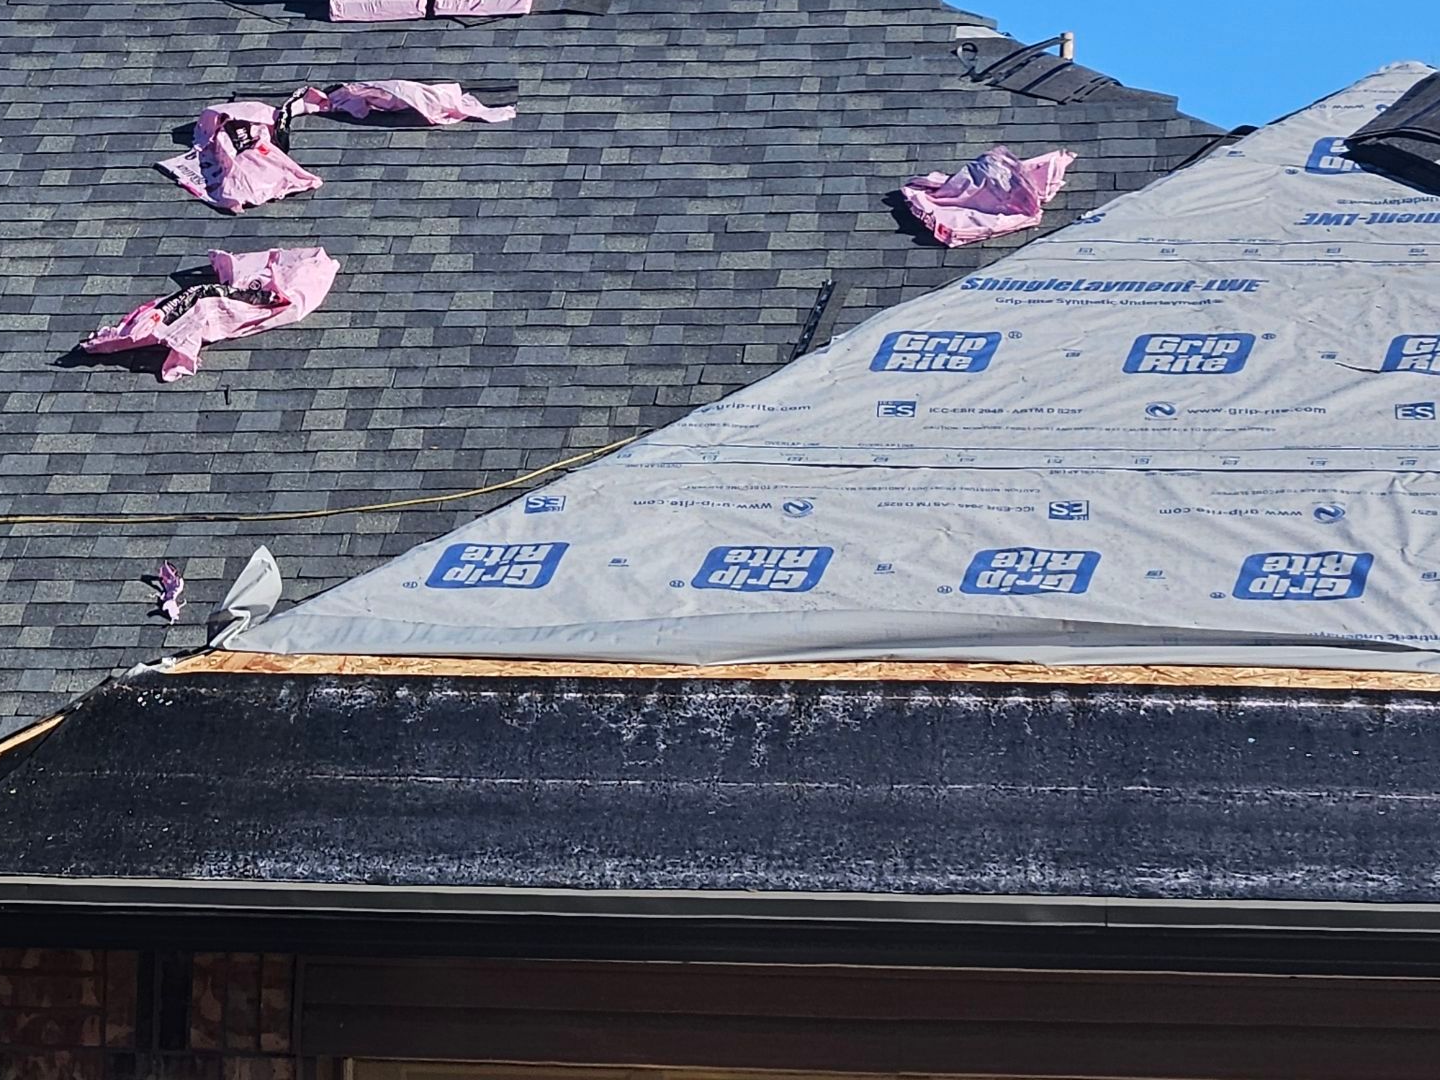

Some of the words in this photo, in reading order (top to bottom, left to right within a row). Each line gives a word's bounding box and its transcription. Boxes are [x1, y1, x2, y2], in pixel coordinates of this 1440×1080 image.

[961, 276, 1269, 292] ShingleLayment-LWE
[893, 333, 987, 352] Grip
[1145, 336, 1241, 355] Grip
[885, 353, 973, 371] Rite
[1138, 354, 1228, 372] Rite
[699, 402, 811, 413] w.grip-rite.com
[880, 406, 915, 418] ES
[1187, 405, 1327, 415] www.grip-rite.com
[1397, 406, 1434, 419] ES
[528, 497, 564, 508] ES
[1051, 501, 1088, 516] ES
[1159, 507, 1303, 517] www.grip-rite.com
[460, 544, 553, 566] Rite
[724, 549, 818, 568] Rite
[991, 550, 1085, 572] Rite
[442, 563, 542, 585] Grip
[1262, 554, 1358, 576] Rite
[707, 565, 808, 589] Grip
[976, 570, 1077, 592] Grip
[1248, 574, 1352, 598] Grip
